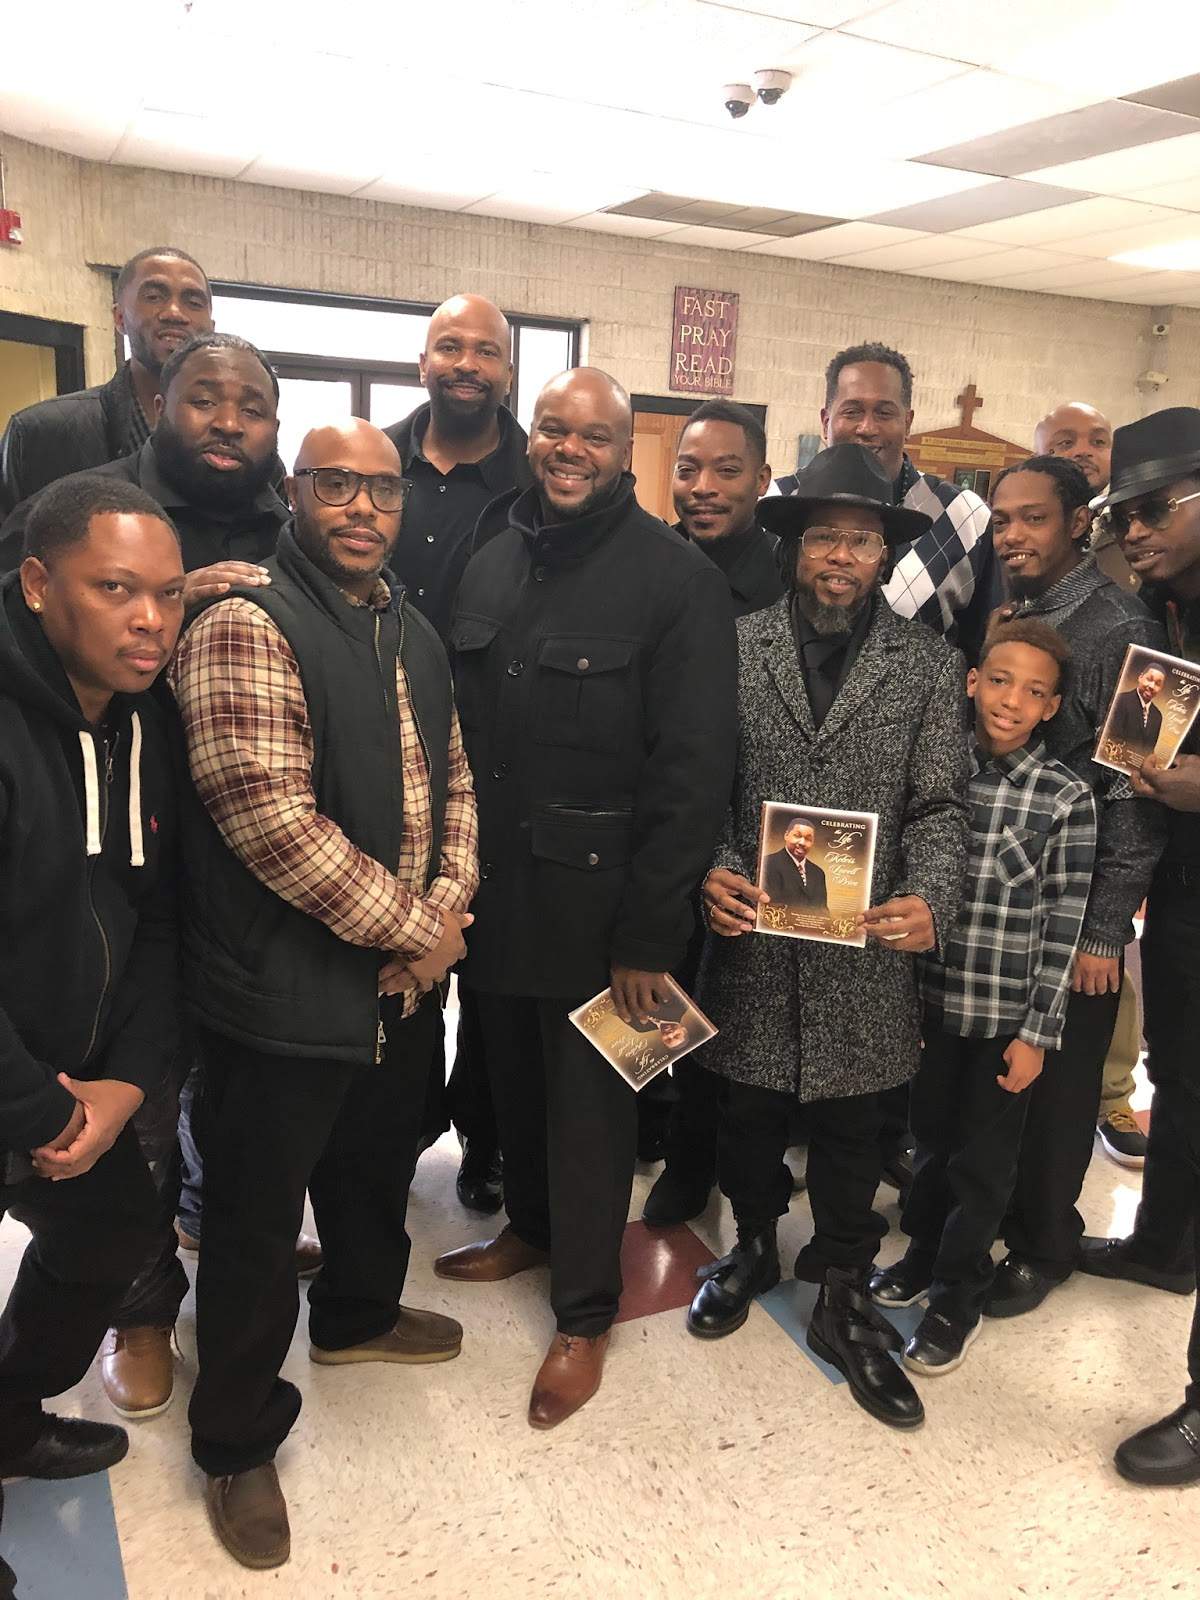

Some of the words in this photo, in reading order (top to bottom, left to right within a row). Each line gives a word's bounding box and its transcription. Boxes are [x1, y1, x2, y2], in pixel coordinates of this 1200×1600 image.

[683, 296, 730, 319] FAST
[680, 324, 731, 347] PRAY
[675, 352, 732, 375] READ
[674, 374, 701, 386] YOUR
[704, 377, 732, 389] BIBLE
[821, 820, 866, 830] CELEBRATING
[827, 831, 863, 849] Life
